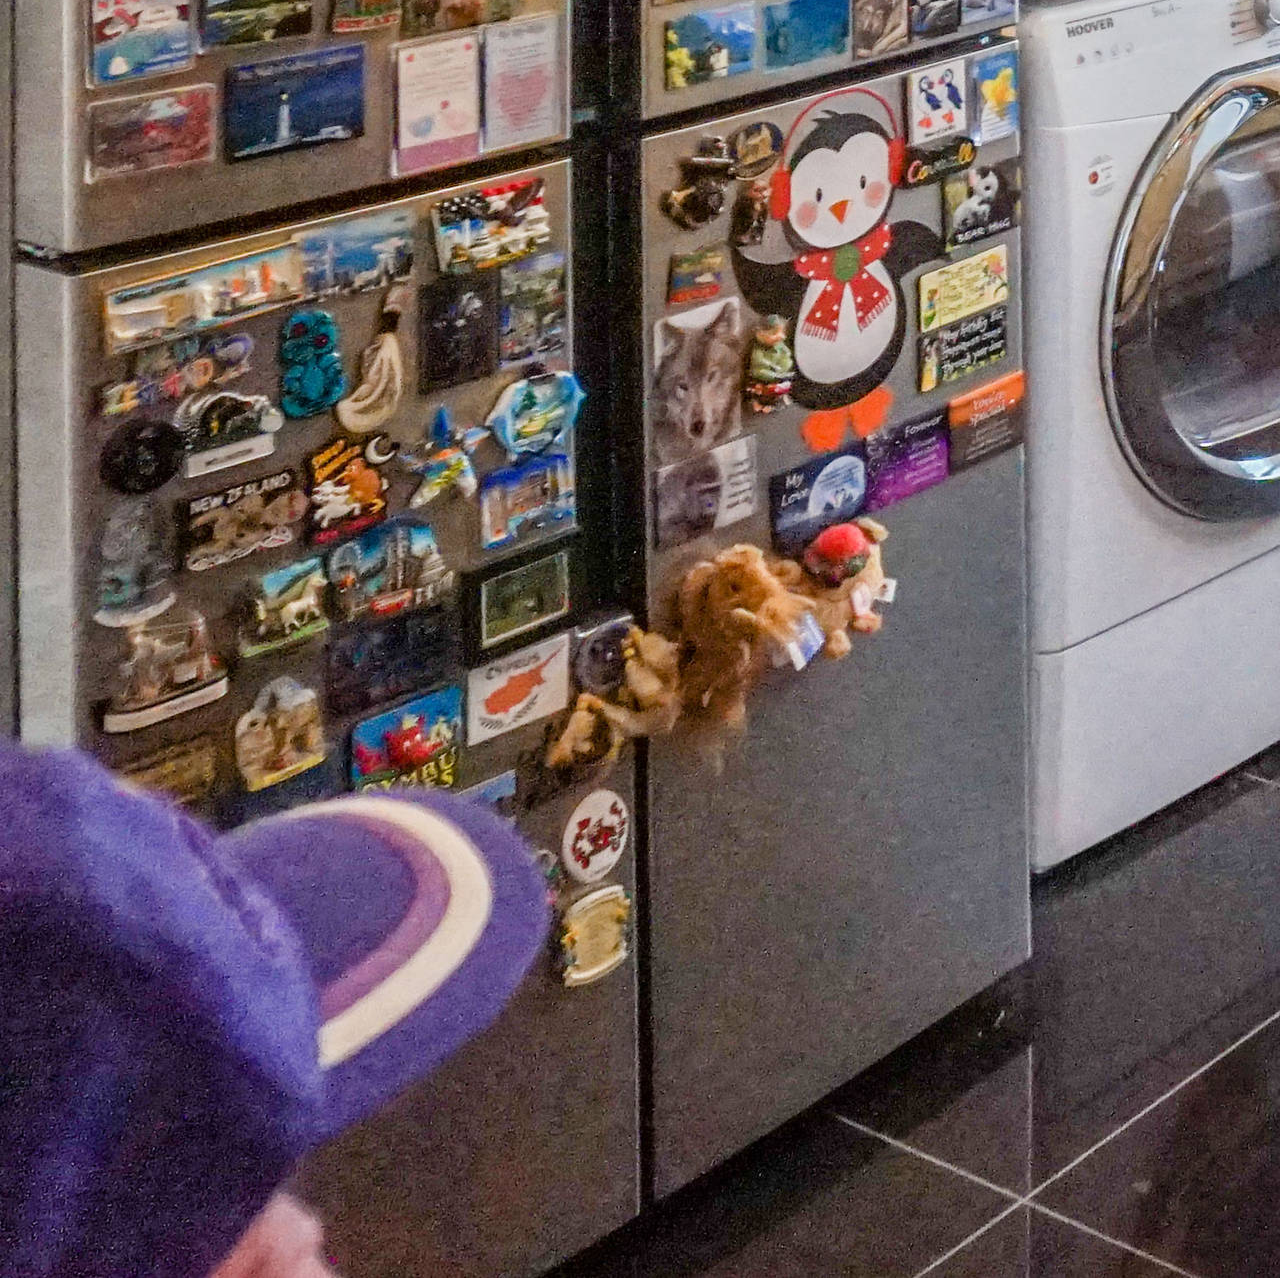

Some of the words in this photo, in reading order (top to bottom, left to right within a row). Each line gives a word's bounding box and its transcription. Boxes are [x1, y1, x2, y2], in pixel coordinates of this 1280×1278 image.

[1066, 17, 1115, 38] HOOVER
[190, 494, 224, 515] NEW
[226, 472, 291, 504] ZEALAND
